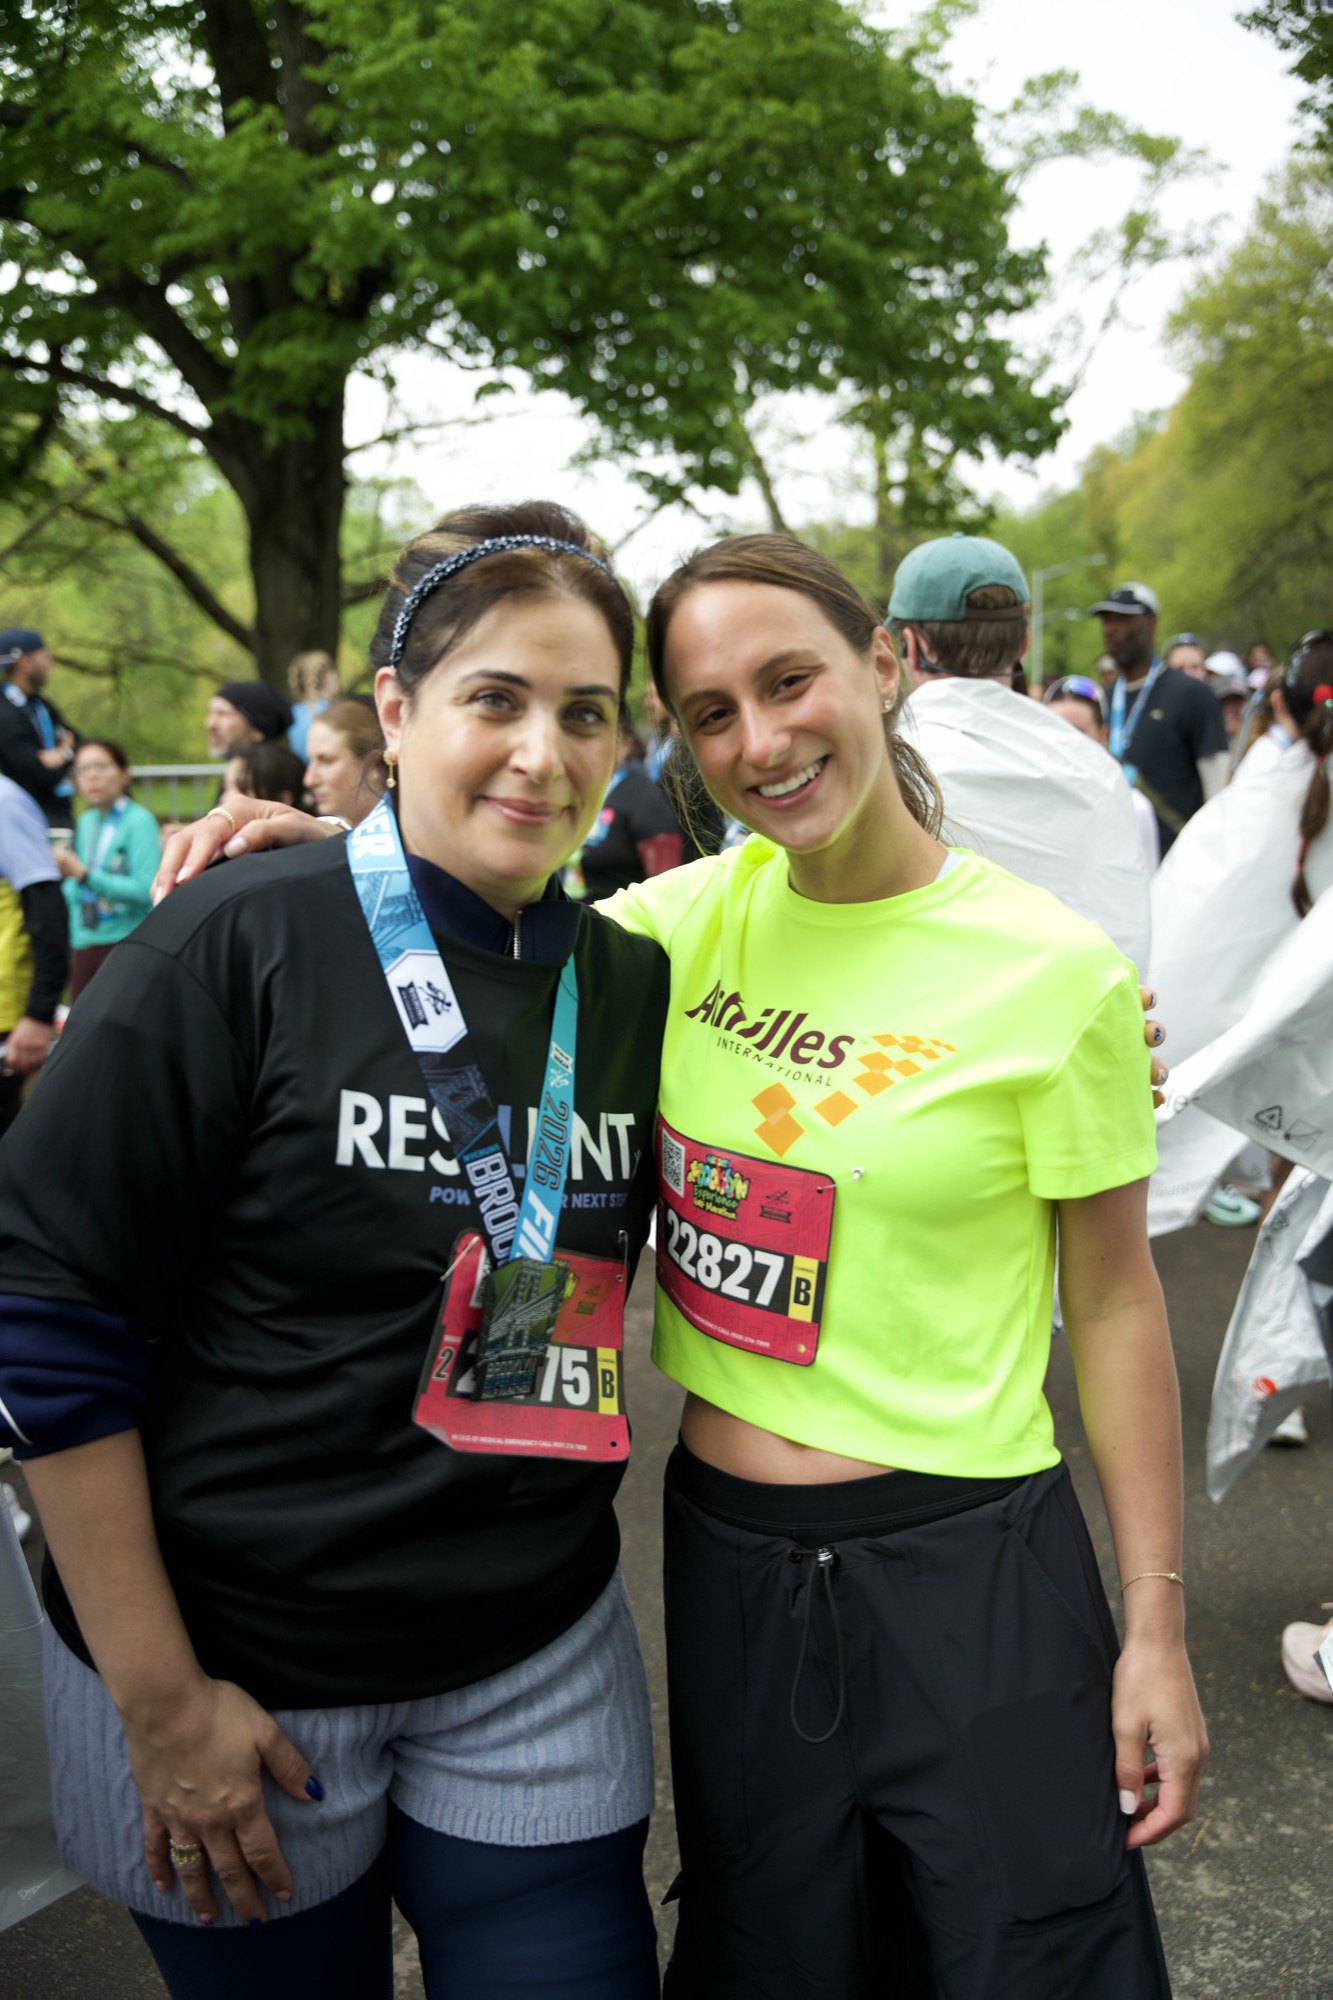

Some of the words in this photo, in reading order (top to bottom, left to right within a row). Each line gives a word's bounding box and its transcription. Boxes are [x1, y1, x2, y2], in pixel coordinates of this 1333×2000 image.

[351, 803, 397, 860] ER
[716, 1036, 832, 1087] INTERNATIONAL
[335, 1089, 636, 1182] RESLINT
[532, 1091, 569, 1190] 2026
[429, 1186, 471, 1206] POW
[572, 1193, 607, 1208] NEXT
[465, 1152, 513, 1264] BROO
[667, 1208, 785, 1306] 22827
[793, 1276, 812, 1306] B
[434, 1346, 455, 1381] 2
[601, 1368, 615, 1398] B
